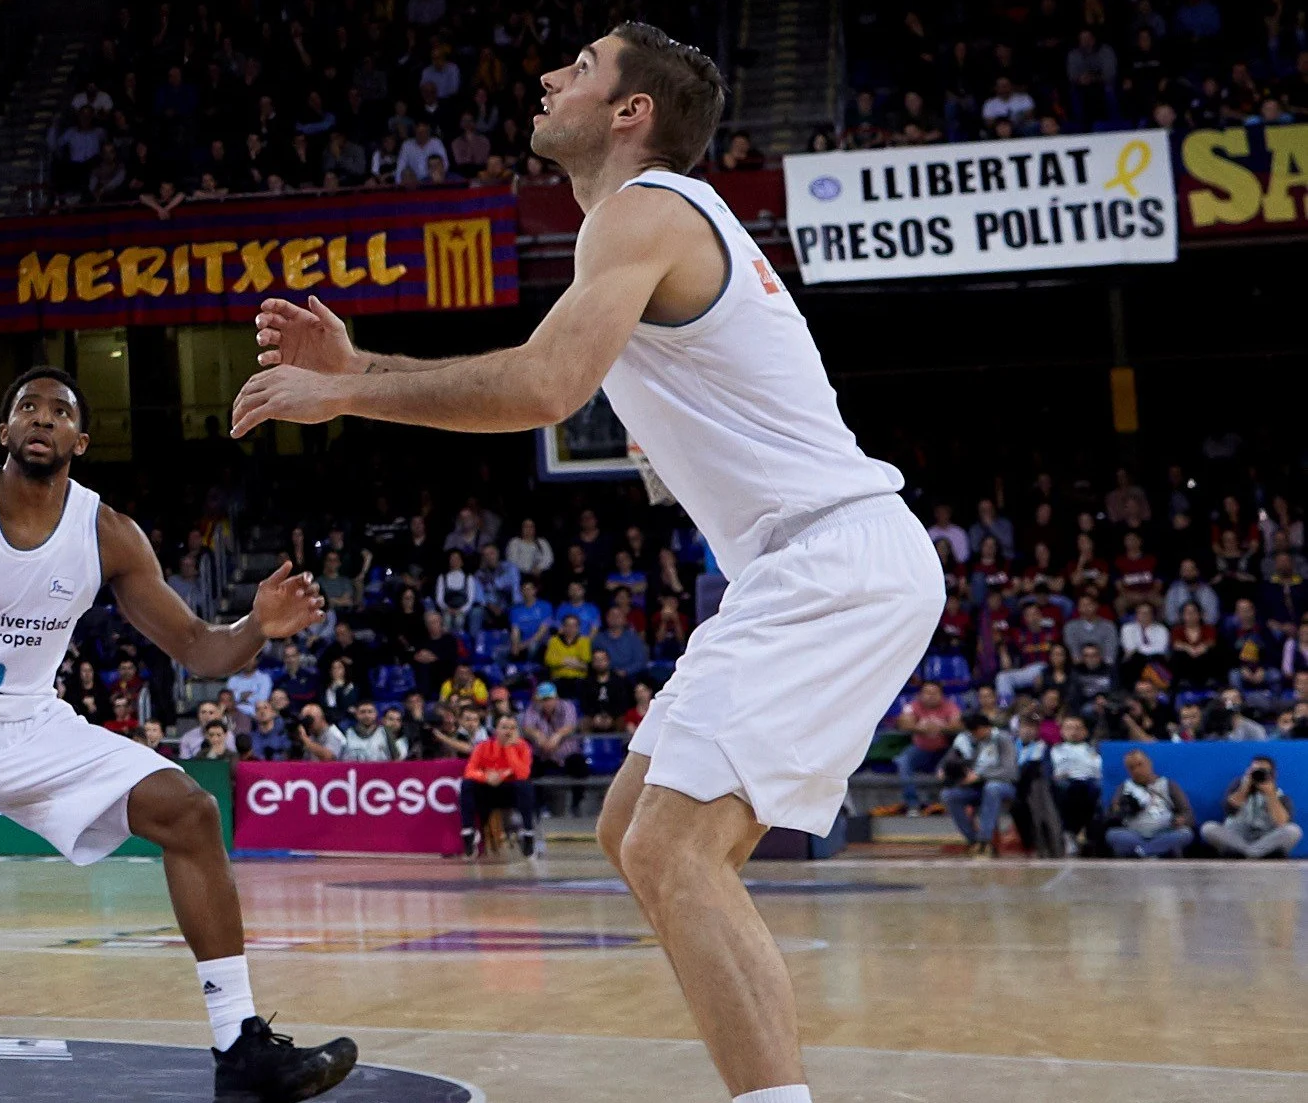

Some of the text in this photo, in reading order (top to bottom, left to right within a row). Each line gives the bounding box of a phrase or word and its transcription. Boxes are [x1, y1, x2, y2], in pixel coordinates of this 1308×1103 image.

[861, 147, 1091, 203] LLIBERTAT
[796, 196, 1166, 265] PRESOS POLÍTICS
[17, 231, 407, 303] MERITXELL
[247, 768, 462, 816] endesa
